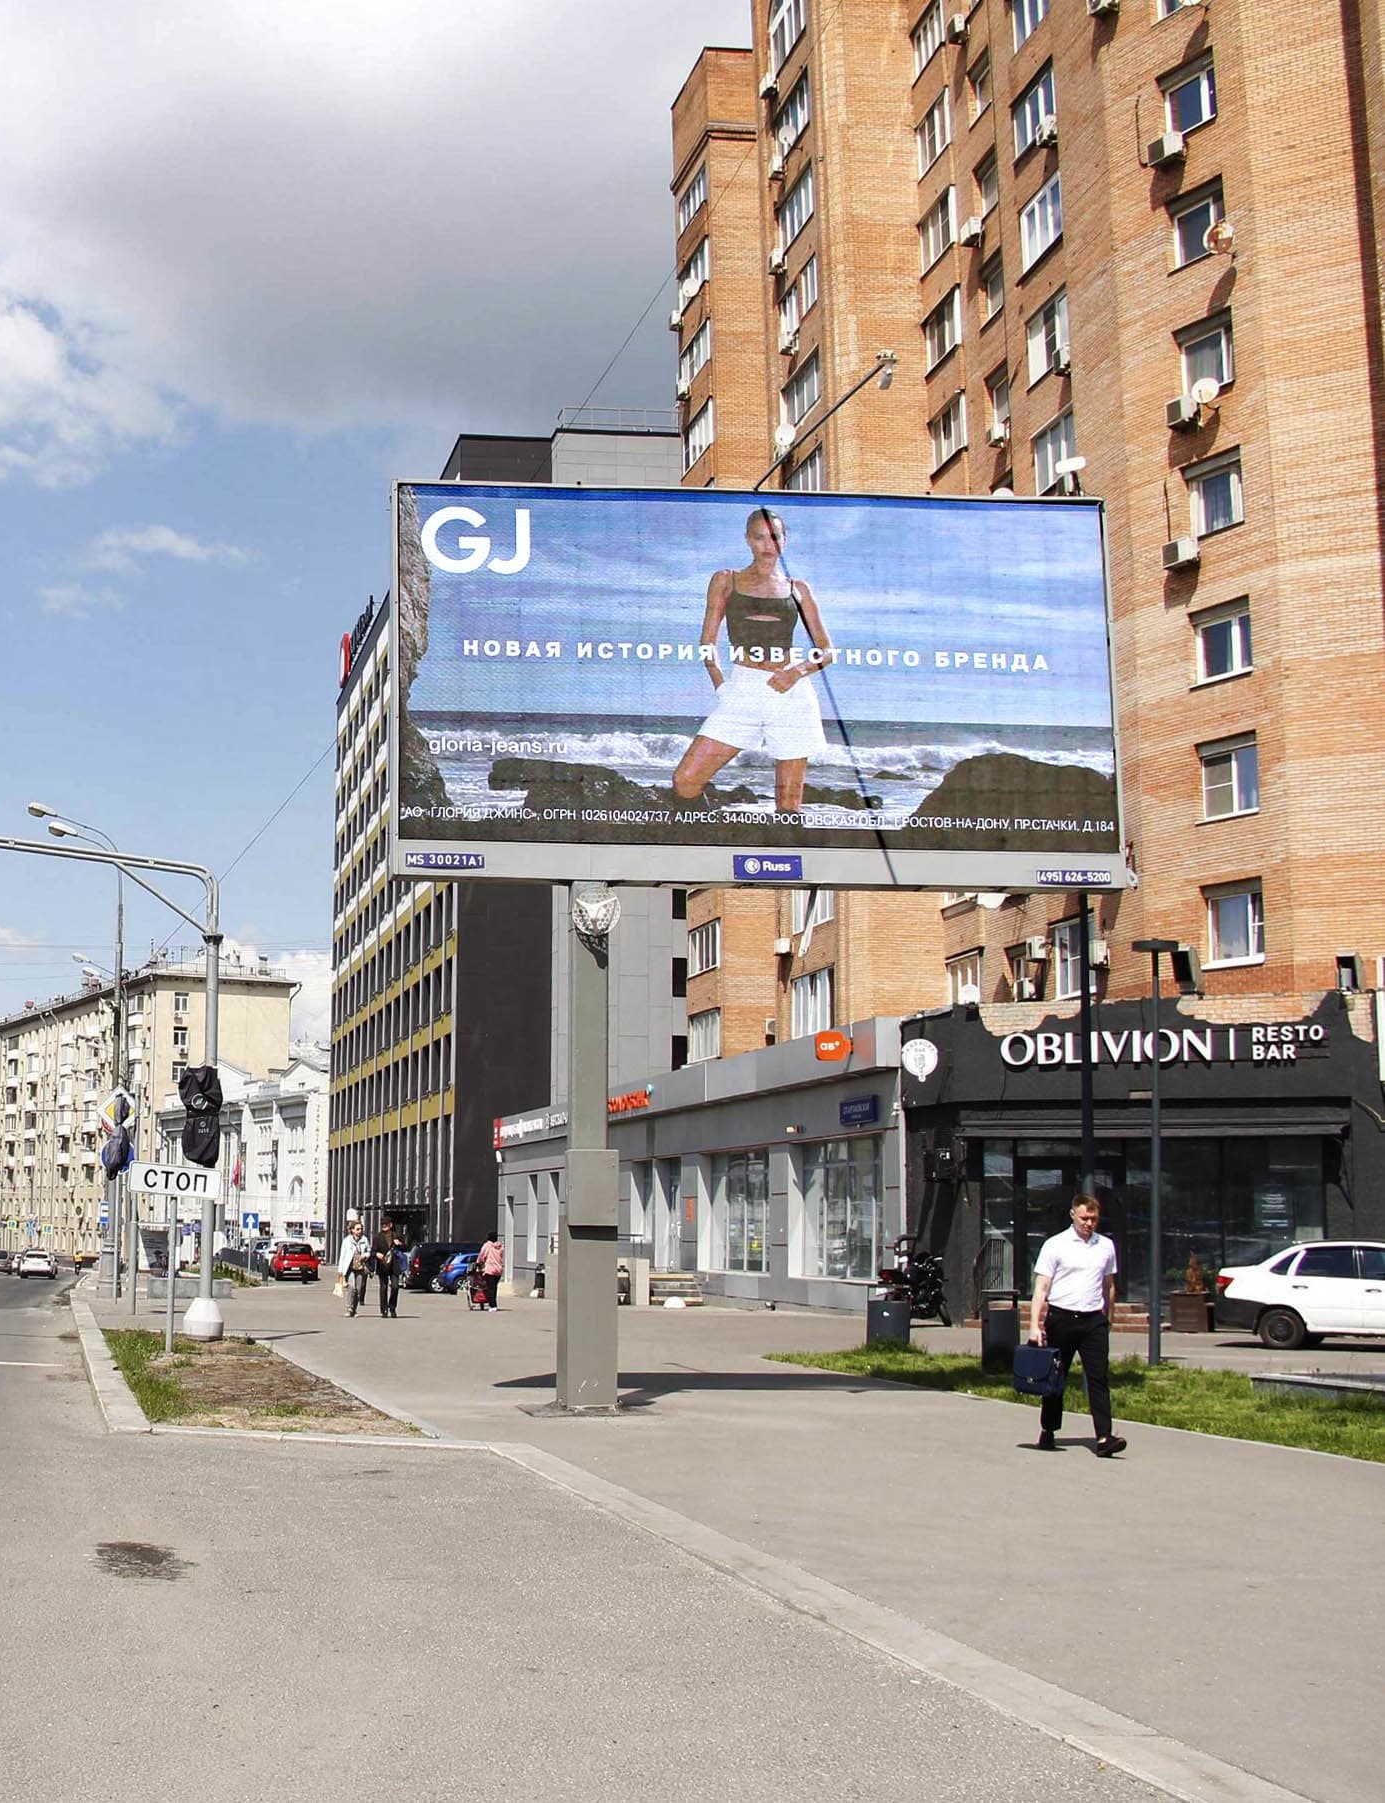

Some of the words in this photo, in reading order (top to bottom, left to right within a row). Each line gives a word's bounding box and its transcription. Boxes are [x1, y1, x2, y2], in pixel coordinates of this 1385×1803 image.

[420, 506, 531, 575] GJ
[464, 640, 561, 658] НОВАЯ
[577, 642, 714, 661] ИСТОРИЯ
[730, 645, 920, 667] ИЗВЕСТНОГО
[935, 651, 1049, 672] БРЕНДА
[429, 737, 568, 755] gloria-jeans.ru
[404, 806, 422, 817] АО
[543, 808, 576, 820] ОГРН
[674, 811, 720, 824] АДРЕС:
[722, 813, 770, 825] 344090,
[773, 814, 856, 826] РОСТОВСКАЯ
[407, 855, 424, 865] MS
[429, 854, 483, 866] 30021A1
[763, 861, 791, 872] Russ
[1036, 870, 1062, 882] (495)
[1064, 870, 1111, 882] 626-5200
[1251, 1025, 1324, 1042] RESTO
[1000, 1029, 1213, 1065] OBLIVION
[1251, 1043, 1297, 1060] BAR
[144, 1169, 208, 1193] СТОП
